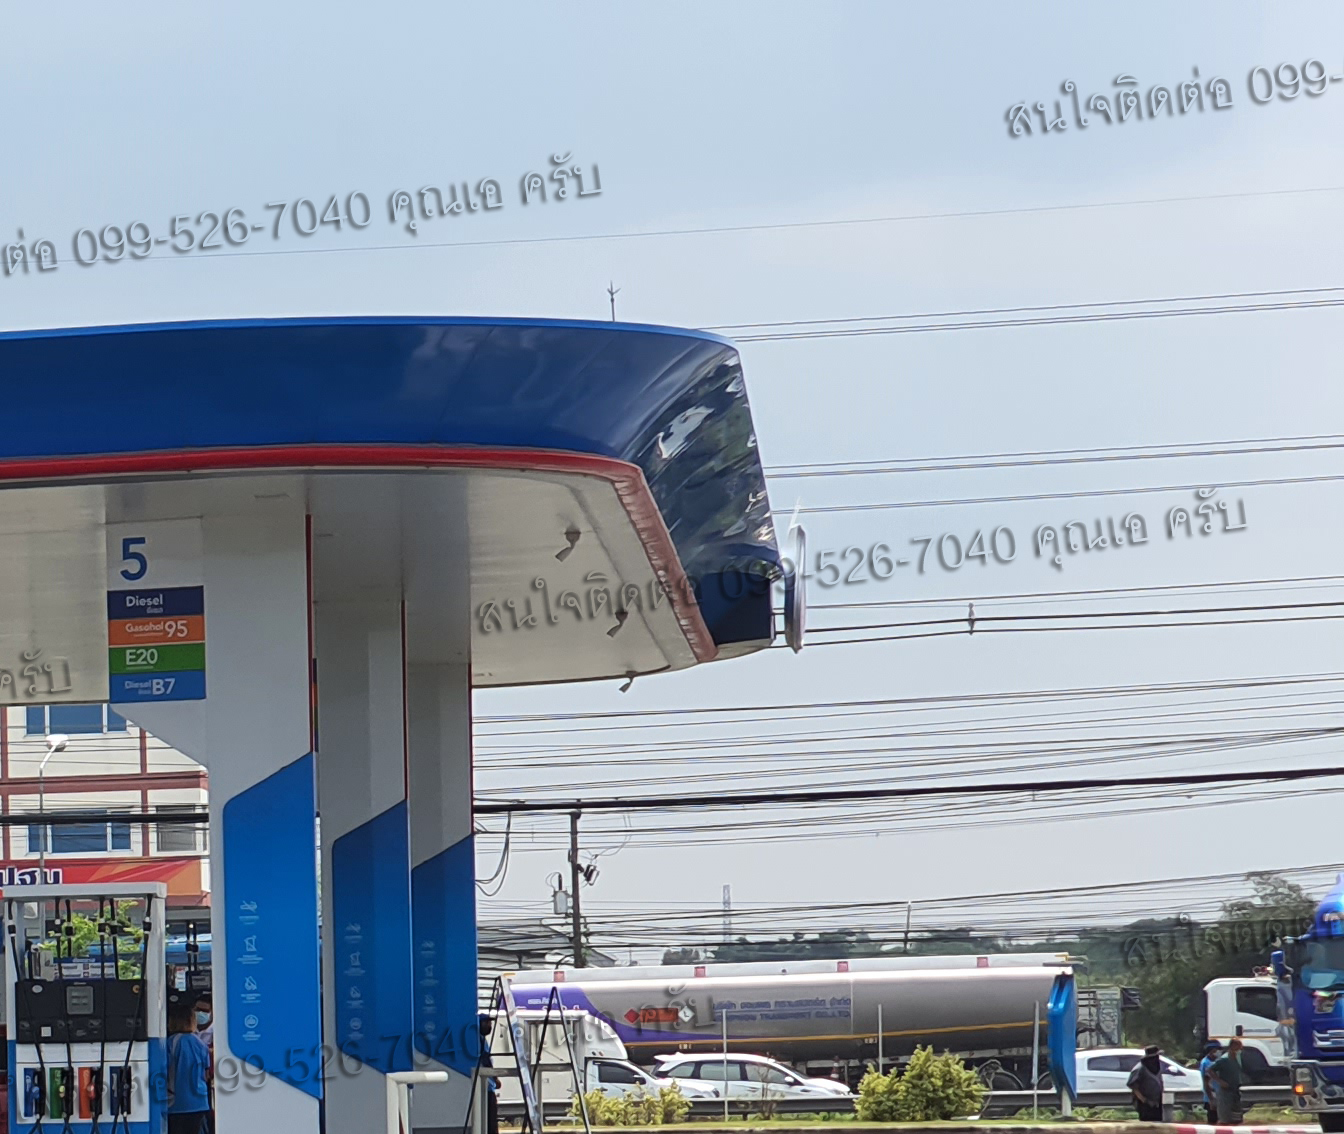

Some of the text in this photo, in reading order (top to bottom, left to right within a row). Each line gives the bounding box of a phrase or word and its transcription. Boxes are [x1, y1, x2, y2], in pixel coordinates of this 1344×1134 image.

[120, 537, 148, 581] 5
[126, 594, 164, 607] Diesel
[125, 620, 188, 638] Gasohol 95
[125, 648, 158, 666] E20
[124, 678, 176, 695] Diesel B7
